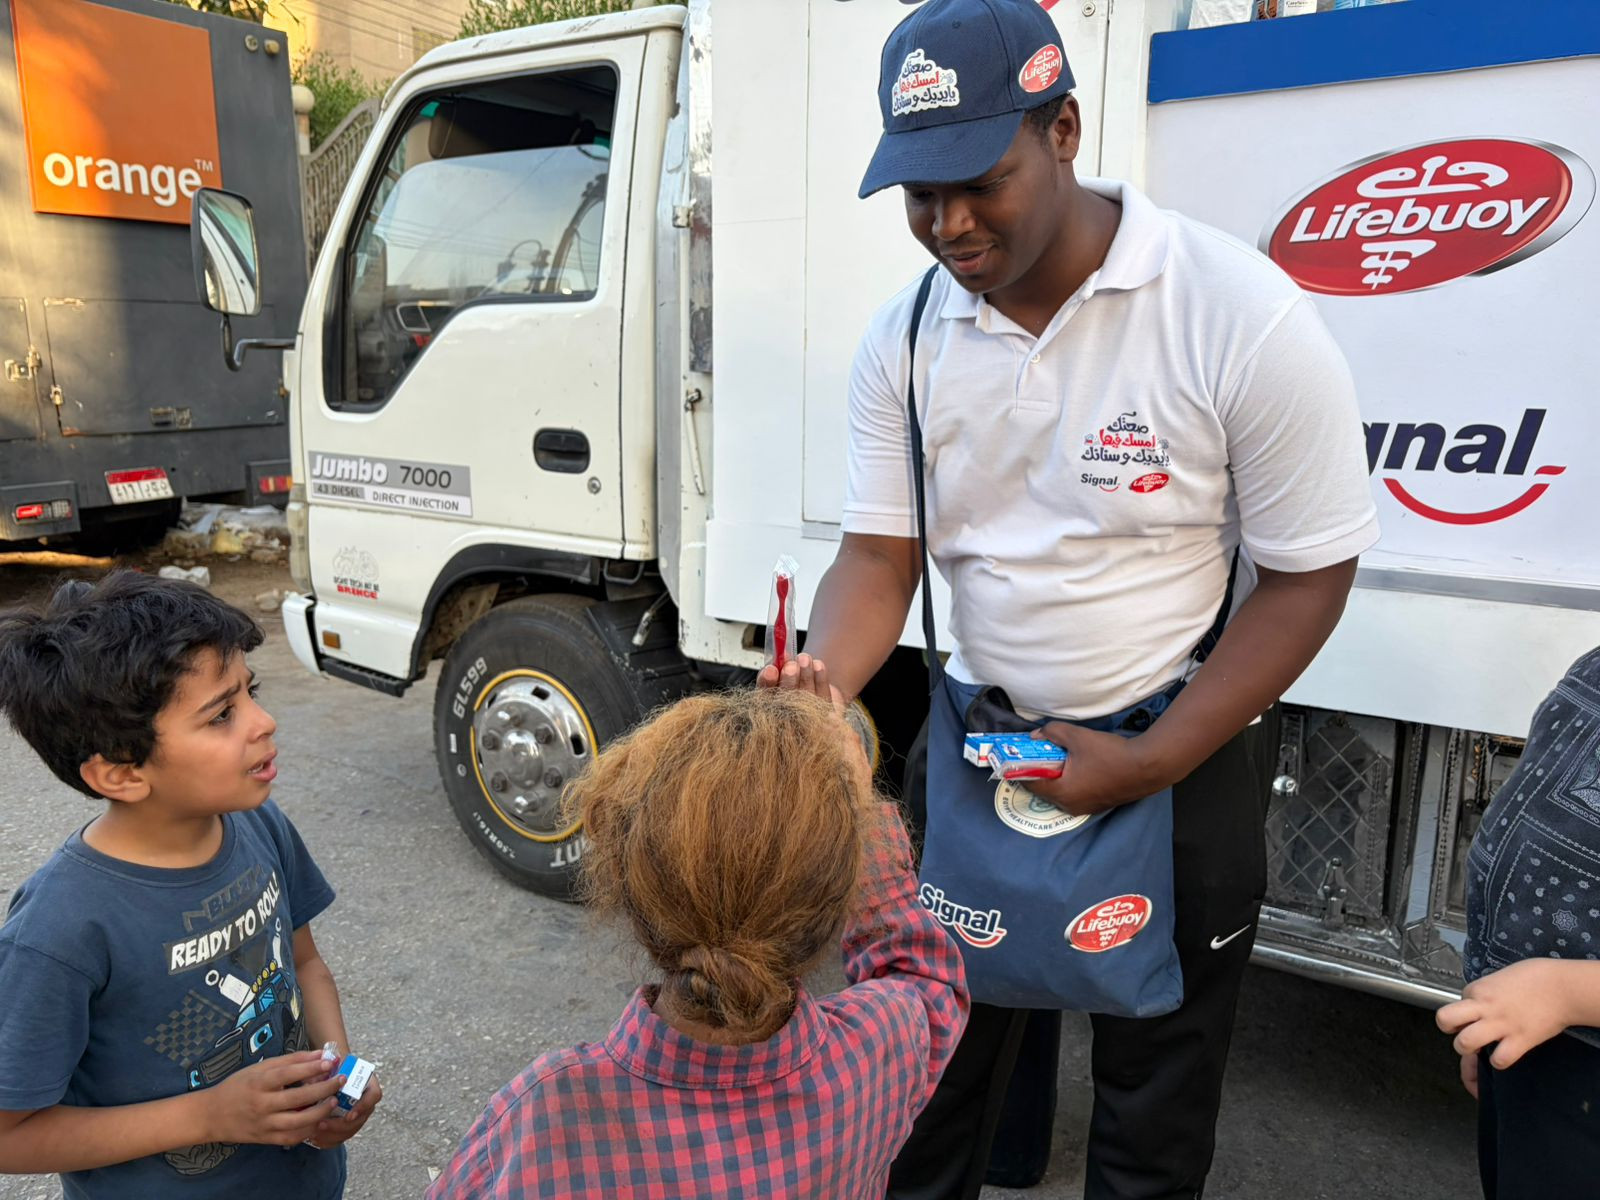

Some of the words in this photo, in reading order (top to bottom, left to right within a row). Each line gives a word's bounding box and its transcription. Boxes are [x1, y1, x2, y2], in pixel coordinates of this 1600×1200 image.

[1024, 57, 1060, 80] Lifebuoy
[43, 152, 202, 207] orange
[1288, 196, 1551, 243] Lifebuoy
[312, 454, 388, 485] Jumbo
[400, 464, 452, 489] 7000
[1081, 473, 1118, 486] Signal
[331, 485, 362, 498] DIESEL
[372, 490, 406, 504] DIRECT
[409, 496, 459, 511] INJECTION
[453, 656, 488, 720] GL599
[1002, 796, 1012, 814] EGYPT
[1010, 813, 1053, 831] HEALTHCARE
[171, 924, 232, 971] READY
[235, 908, 256, 941] TO
[257, 871, 280, 925] ROLL!
[919, 883, 1001, 934] Signal
[1077, 911, 1144, 934] Lifebuoy
